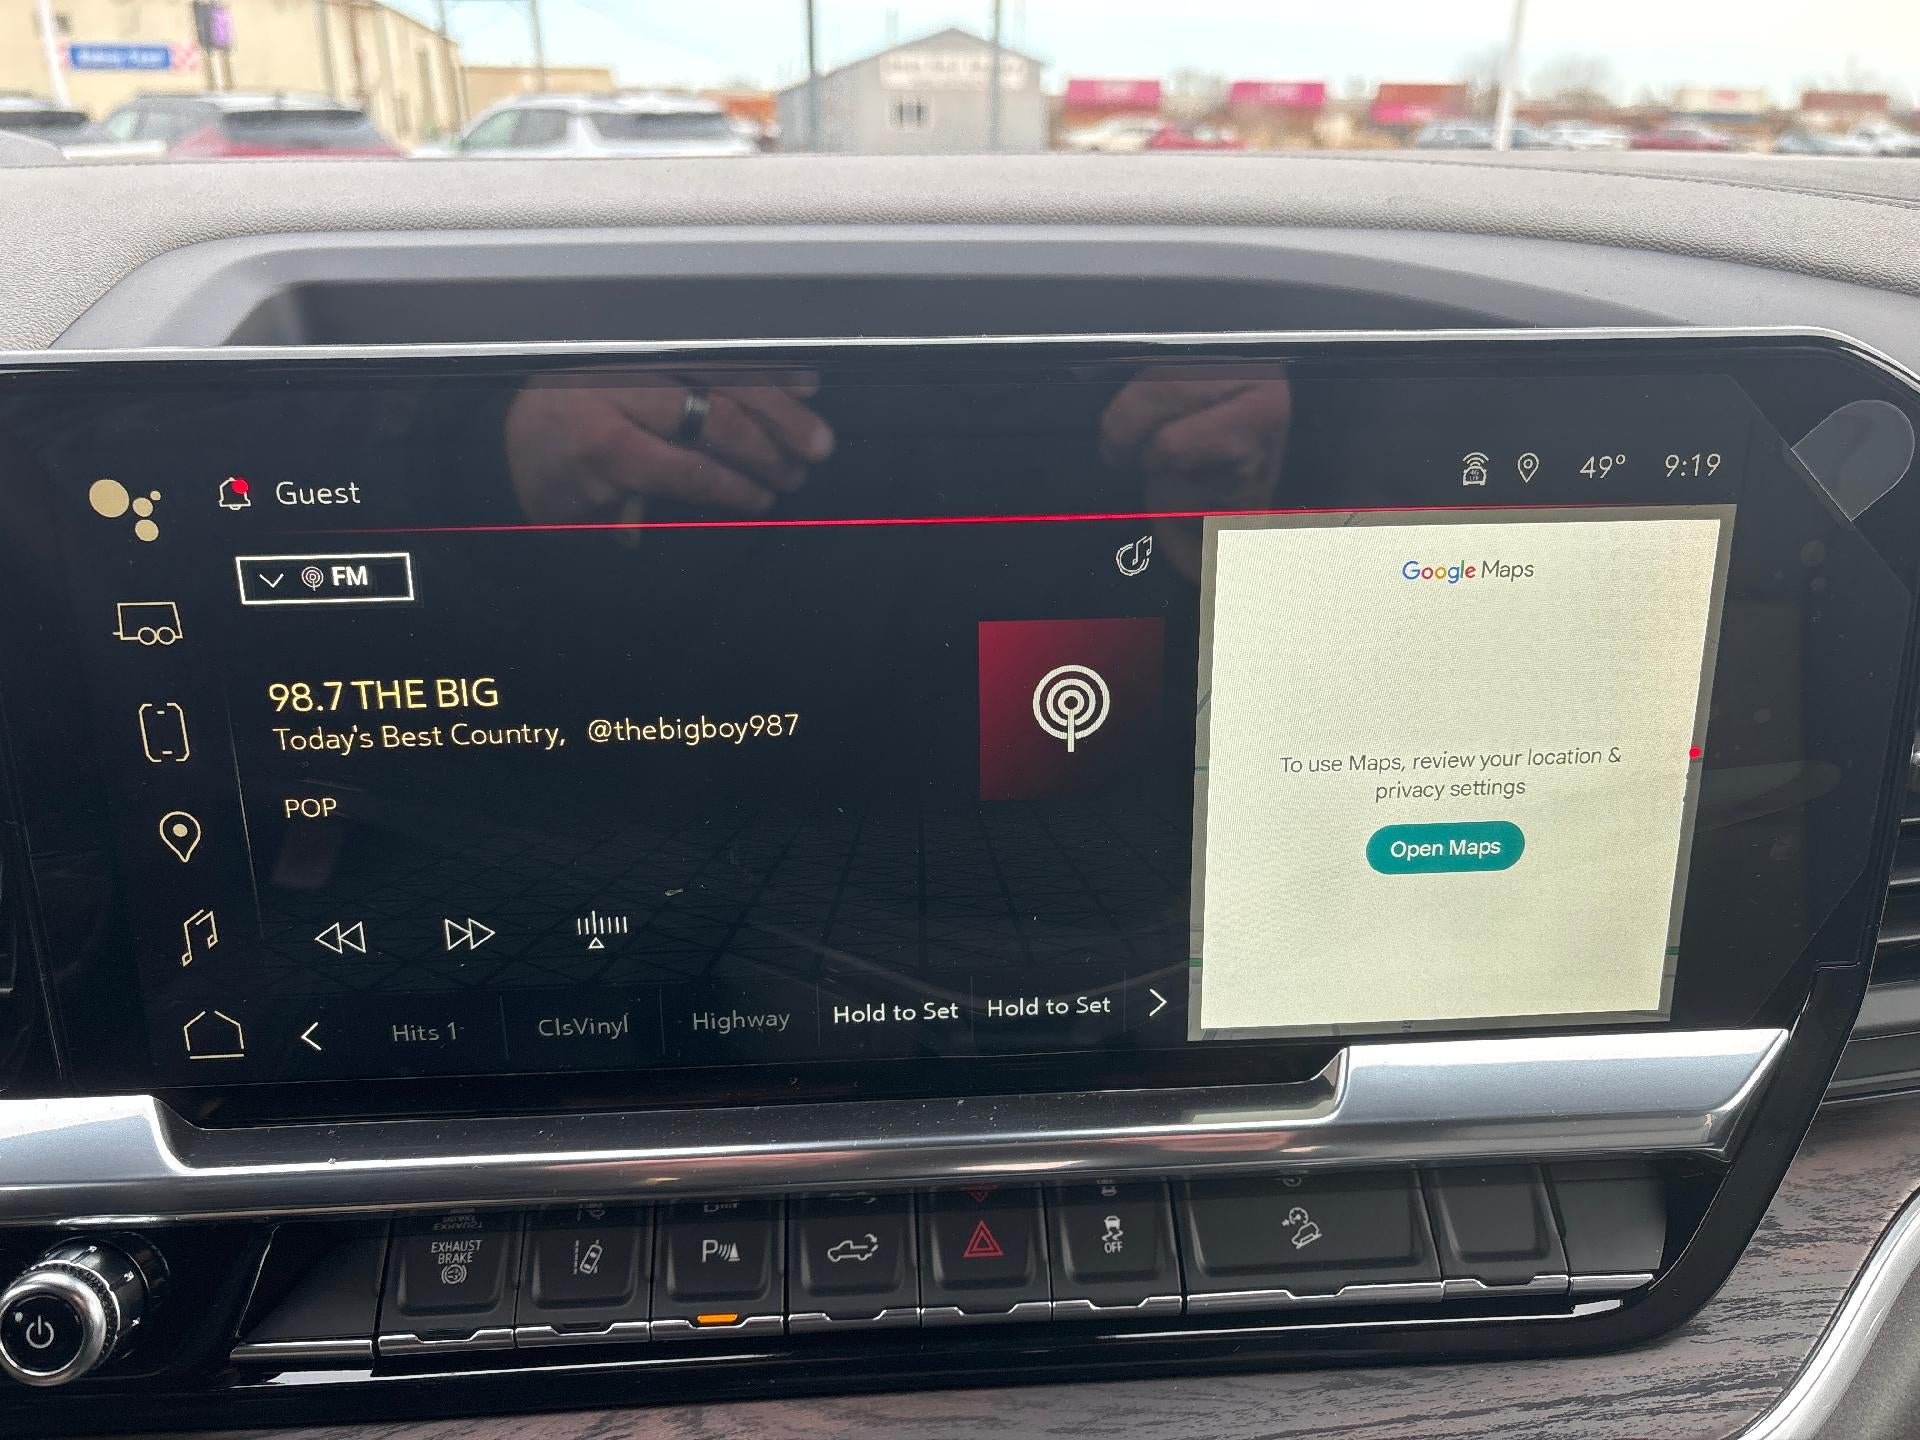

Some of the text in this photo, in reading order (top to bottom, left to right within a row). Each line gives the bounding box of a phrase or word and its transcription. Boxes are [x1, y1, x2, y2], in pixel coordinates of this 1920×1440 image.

[1664, 453, 1721, 478] 9:19
[275, 480, 361, 506] Guest
[331, 565, 368, 586] FM
[1402, 559, 1534, 584] Google Maps
[268, 677, 499, 712] 98.7 THE BIG
[272, 713, 799, 756] Today's Best Country, @thebigboy987
[1280, 746, 1622, 775] To use Maps, review your location &
[1375, 780, 1526, 804] privacy settings
[284, 797, 337, 819] POP
[1390, 839, 1501, 862] Open Maps
[833, 1001, 959, 1024] Hold to Set
[987, 996, 1111, 1017] Hold to Set
[392, 1021, 457, 1042] Hits 1
[538, 1012, 629, 1041] ClsVinyl
[693, 1009, 791, 1035] Highway
[431, 1239, 483, 1253] EXHAUST
[437, 1251, 474, 1265] BRAKE
[702, 1239, 719, 1263] P
[1103, 1240, 1124, 1254] OFF
